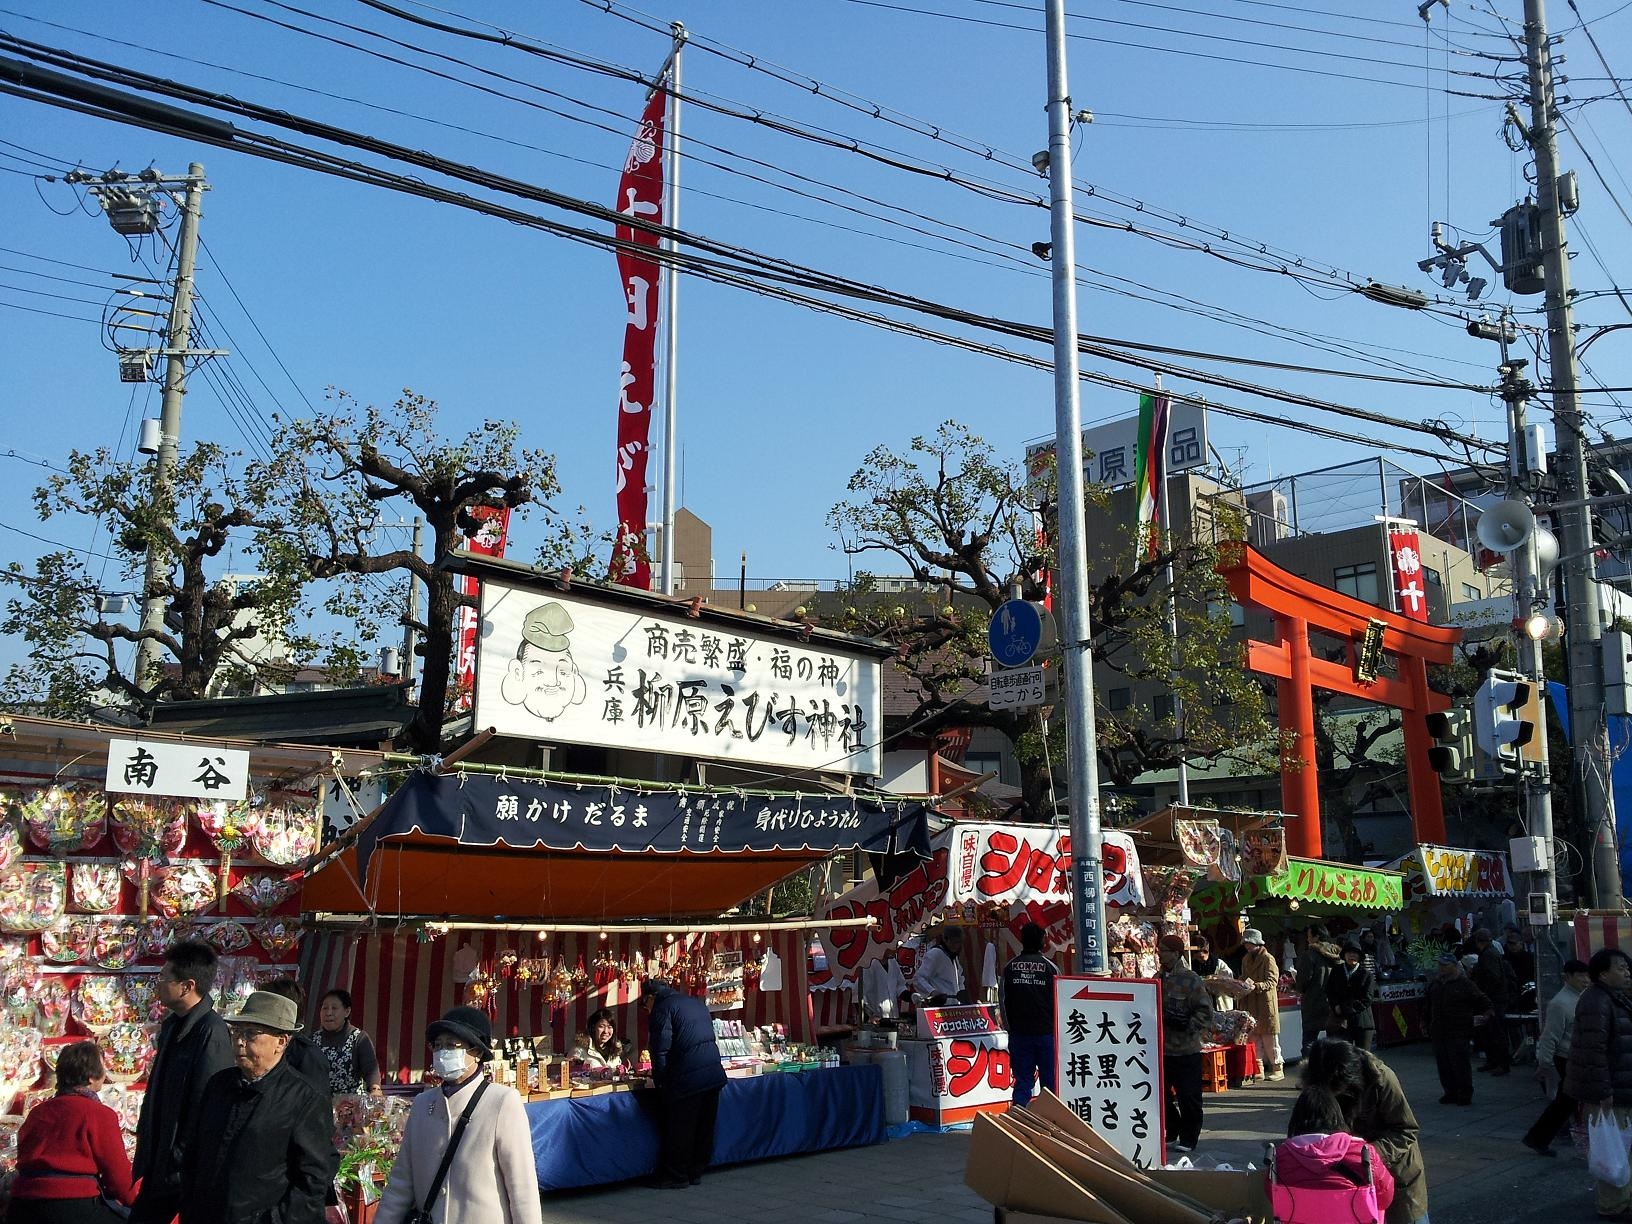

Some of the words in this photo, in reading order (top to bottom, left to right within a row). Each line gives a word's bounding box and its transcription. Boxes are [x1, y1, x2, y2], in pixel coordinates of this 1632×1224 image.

[1400, 580, 1425, 612] 十
[643, 621, 840, 689] 商売繁盛・福の神
[601, 664, 626, 724] 兵庫
[630, 667, 869, 754] 柳原えびす神社
[991, 687, 1043, 704] ここから
[123, 746, 231, 790] 南谷
[1297, 868, 1378, 903] りんごあめ
[1011, 961, 1046, 972] KONAN
[933, 1017, 989, 1034] シロコロホルモン
